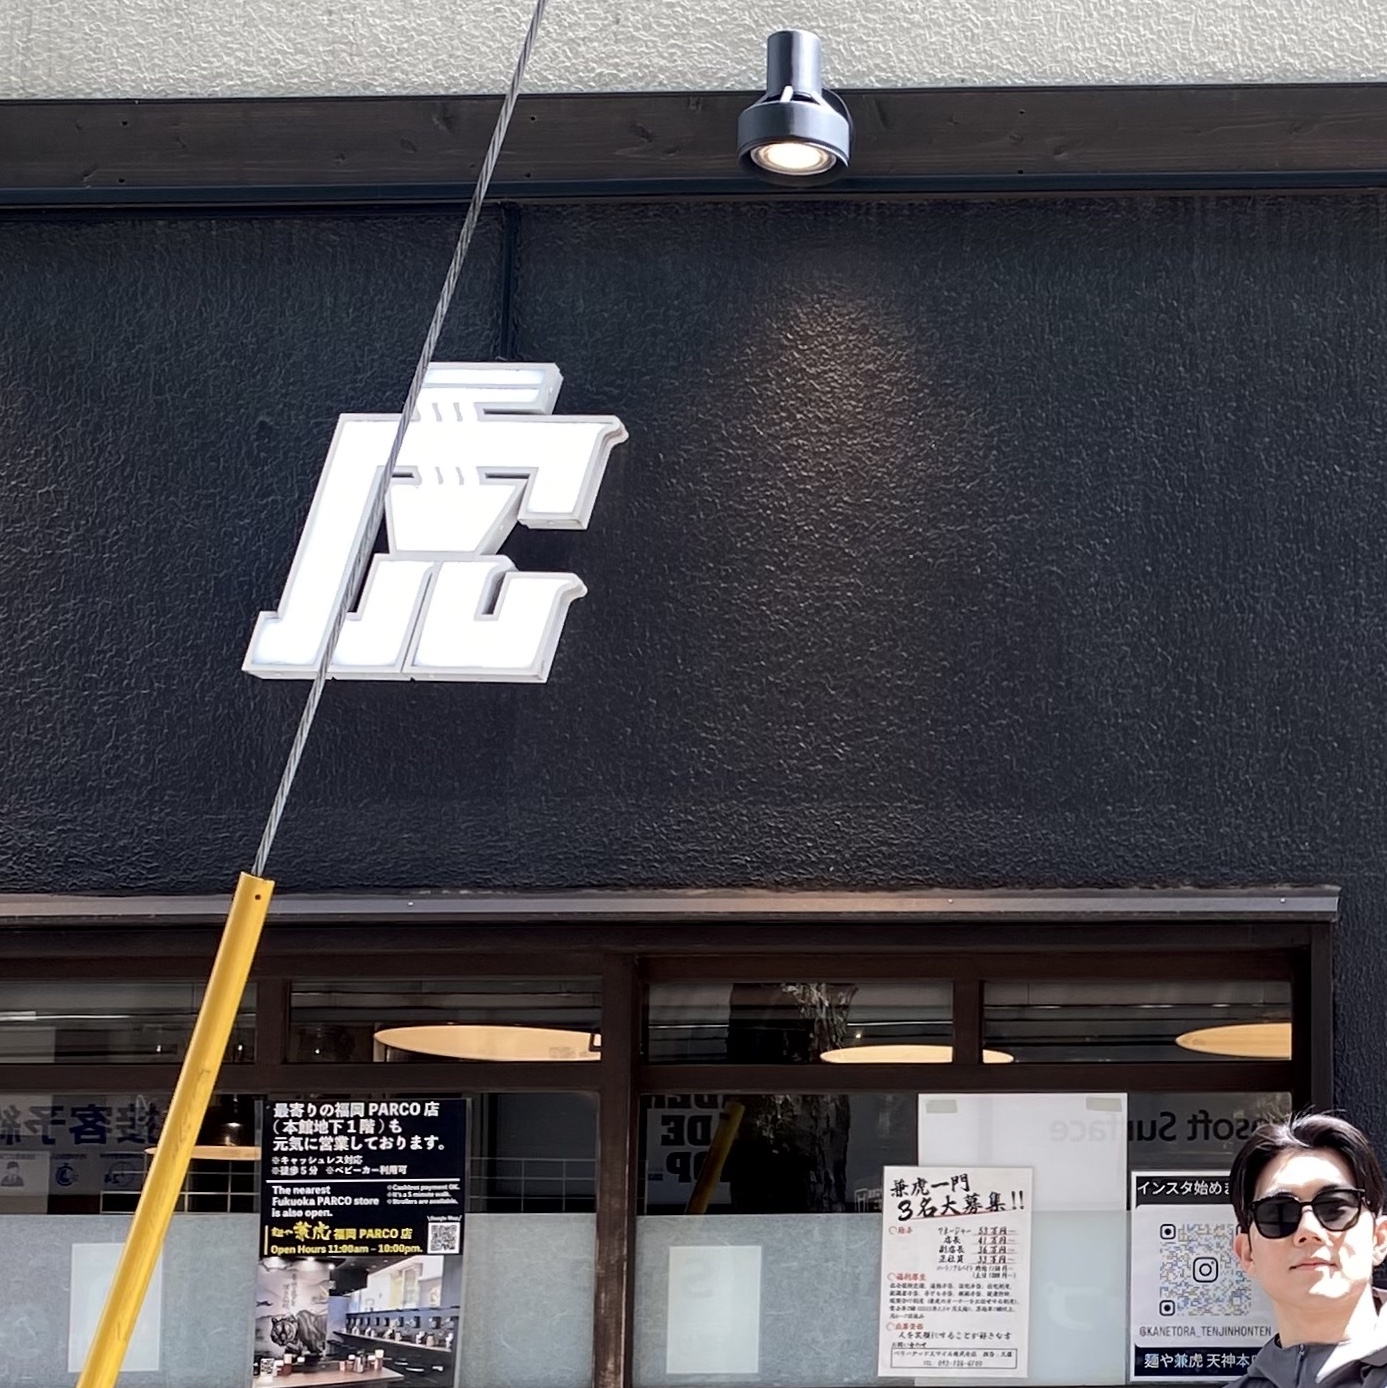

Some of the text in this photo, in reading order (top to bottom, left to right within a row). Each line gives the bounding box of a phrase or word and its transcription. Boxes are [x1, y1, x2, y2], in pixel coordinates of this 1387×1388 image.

[273, 1101, 440, 1118] 最寄りの福岡 PARCO 店
[273, 1135, 445, 1151] 元気に営業しております。
[272, 1185, 331, 1195] The nearest
[272, 1196, 379, 1206] Fukuoka PARCO store
[272, 1208, 333, 1219] is also open.
[359, 1228, 399, 1239] PARCO
[400, 1228, 413, 1240] 店
[270, 1245, 296, 1255] Open
[298, 1245, 326, 1254] Hours
[328, 1244, 369, 1254] 11:00am
[378, 1244, 423, 1255] 10:00pm.
[1139, 1325, 1272, 1337] @KANETORA_TENJINHONTEN
[1144, 1353, 1203, 1369] 麺や兼虎
